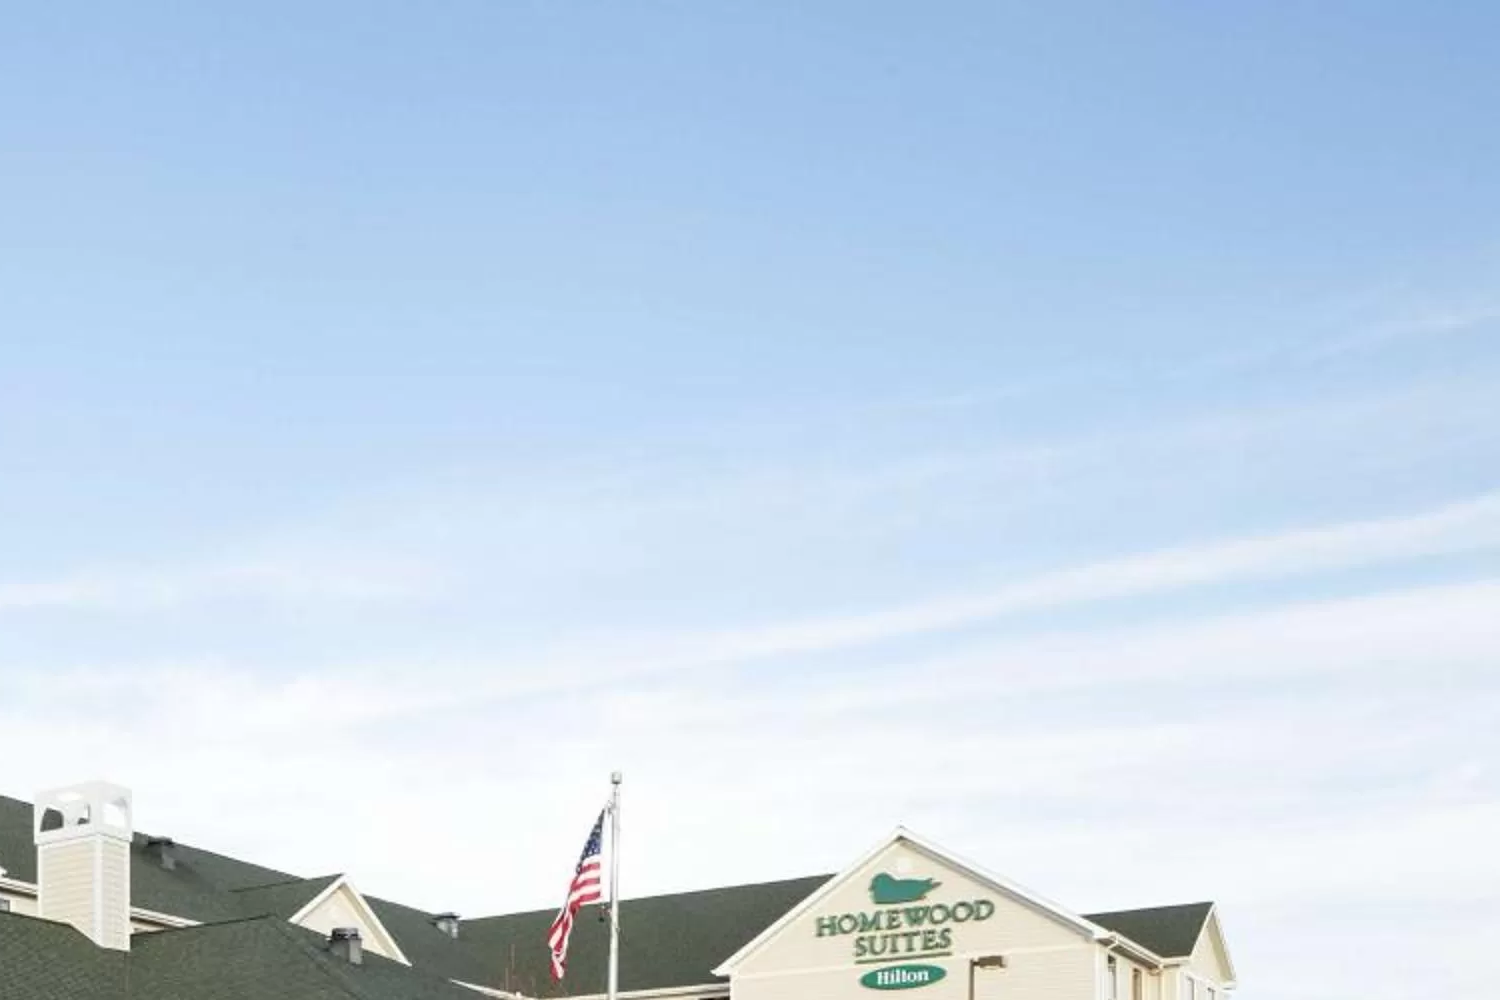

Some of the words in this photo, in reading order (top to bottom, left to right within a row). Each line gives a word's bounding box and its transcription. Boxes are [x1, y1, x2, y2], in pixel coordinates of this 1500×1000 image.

[815, 900, 995, 937] HOMEWOOD
[854, 928, 952, 957] SUITES
[876, 969, 930, 985] Hilton
